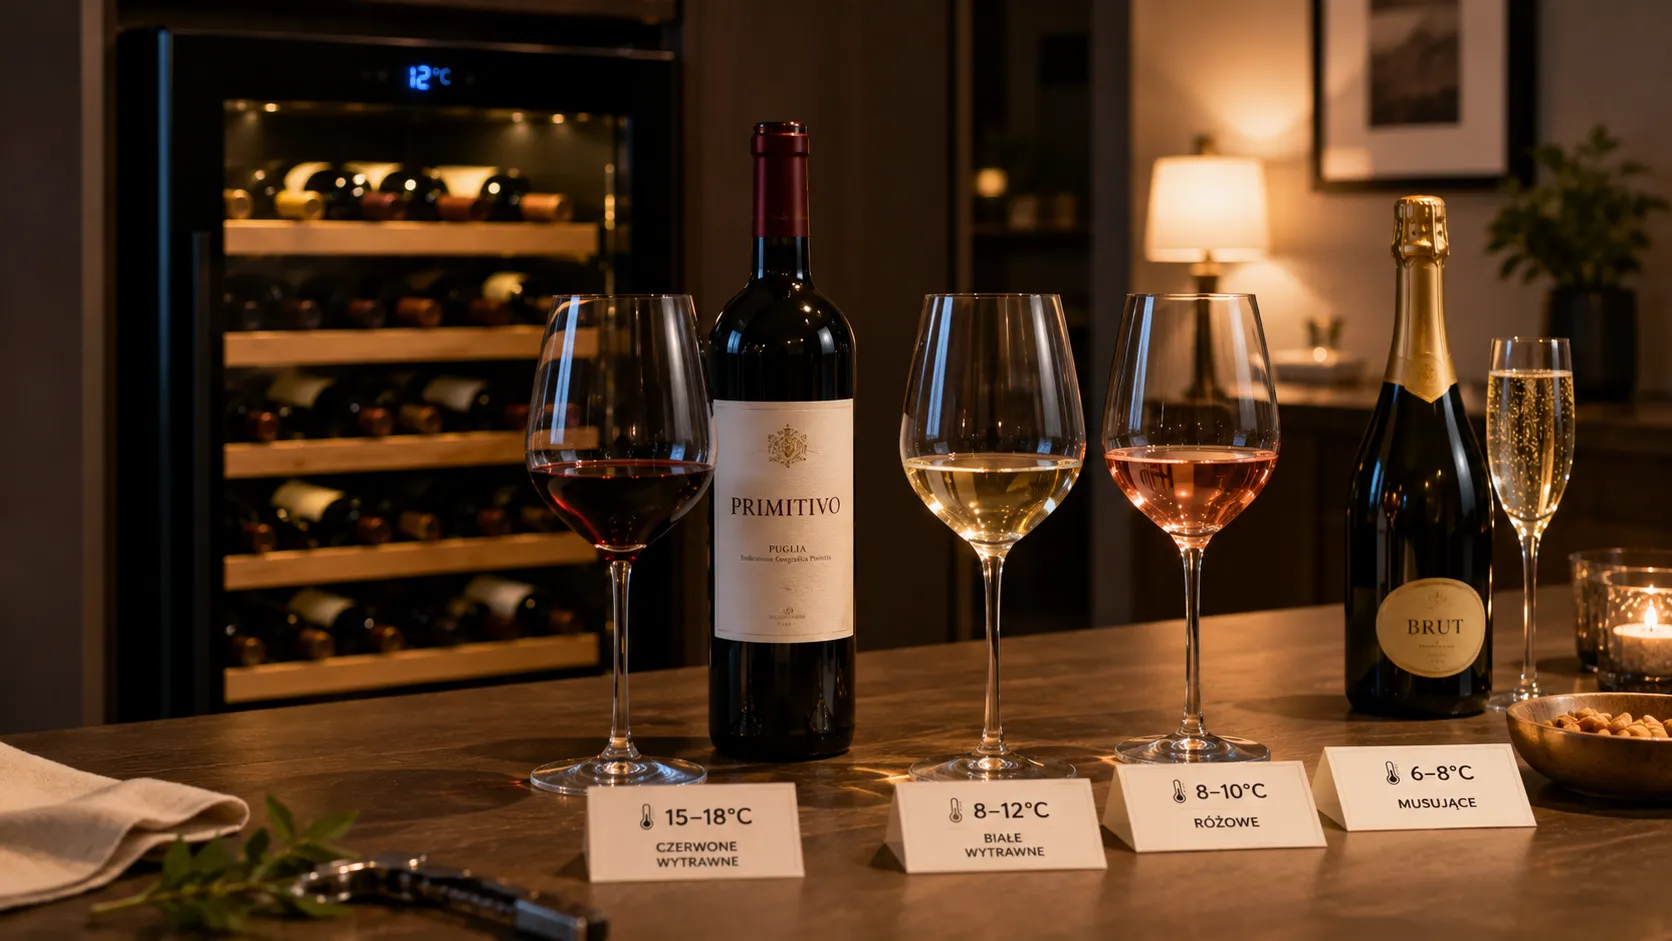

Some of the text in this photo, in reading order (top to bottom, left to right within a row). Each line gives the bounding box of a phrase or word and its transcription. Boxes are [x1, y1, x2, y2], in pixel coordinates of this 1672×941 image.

[409, 64, 452, 91] 12°C
[731, 496, 840, 516] PRIMITIVO
[769, 544, 806, 553] PUGLIA
[1407, 618, 1464, 635] BRUT
[1398, 797, 1477, 811] MUSUJĄCE
[1194, 815, 1260, 829] RÓŻOWE
[983, 832, 1023, 844] BIAŁE
[656, 841, 738, 853] CZERWONE
[964, 846, 1045, 858] WYTRAWNE
[656, 856, 739, 868] WYTRAWNE
